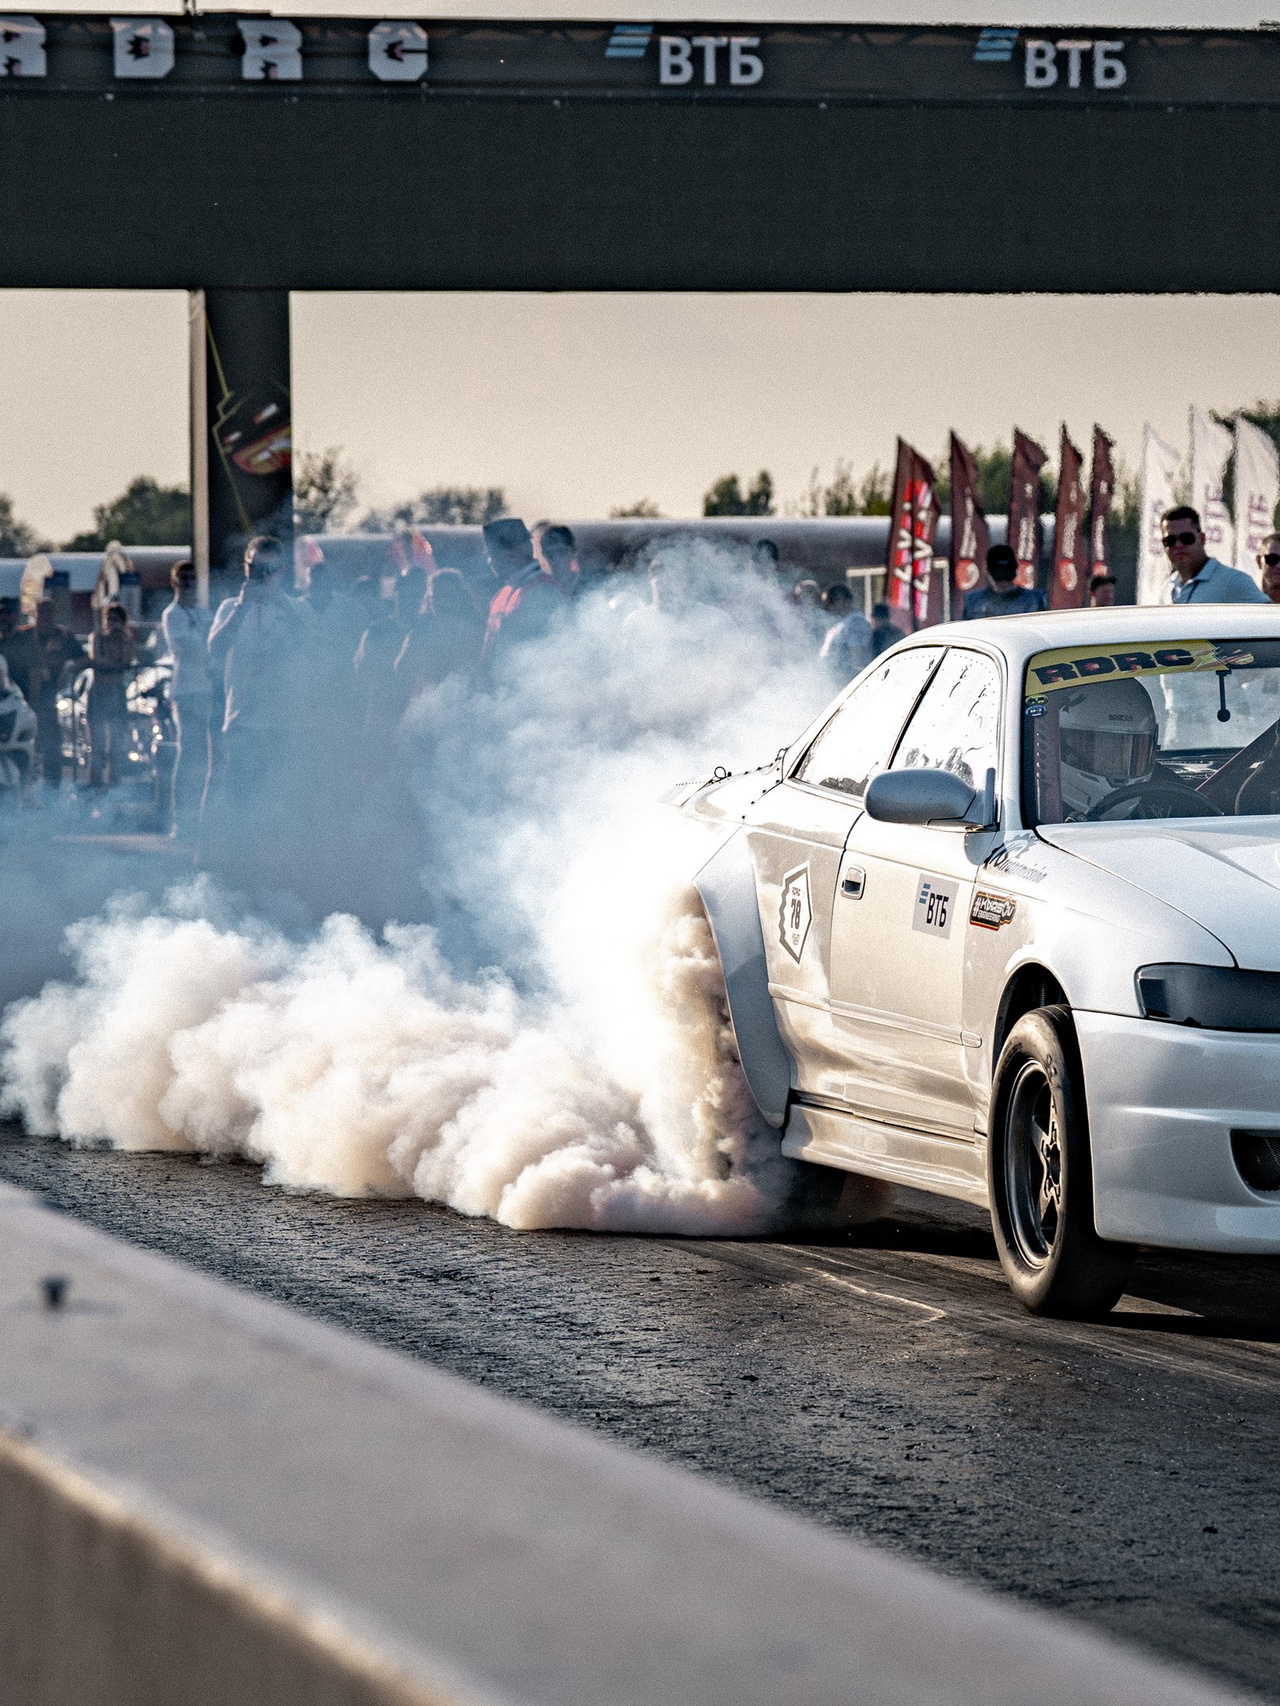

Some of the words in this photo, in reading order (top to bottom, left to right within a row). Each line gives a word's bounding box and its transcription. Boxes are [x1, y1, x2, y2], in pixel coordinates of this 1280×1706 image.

[659, 36, 764, 86] ВТБ
[1024, 40, 1128, 89] ВТБ
[1031, 648, 1195, 686] RDRC
[791, 898, 802, 930] 78
[926, 892, 949, 927] ВТБ
